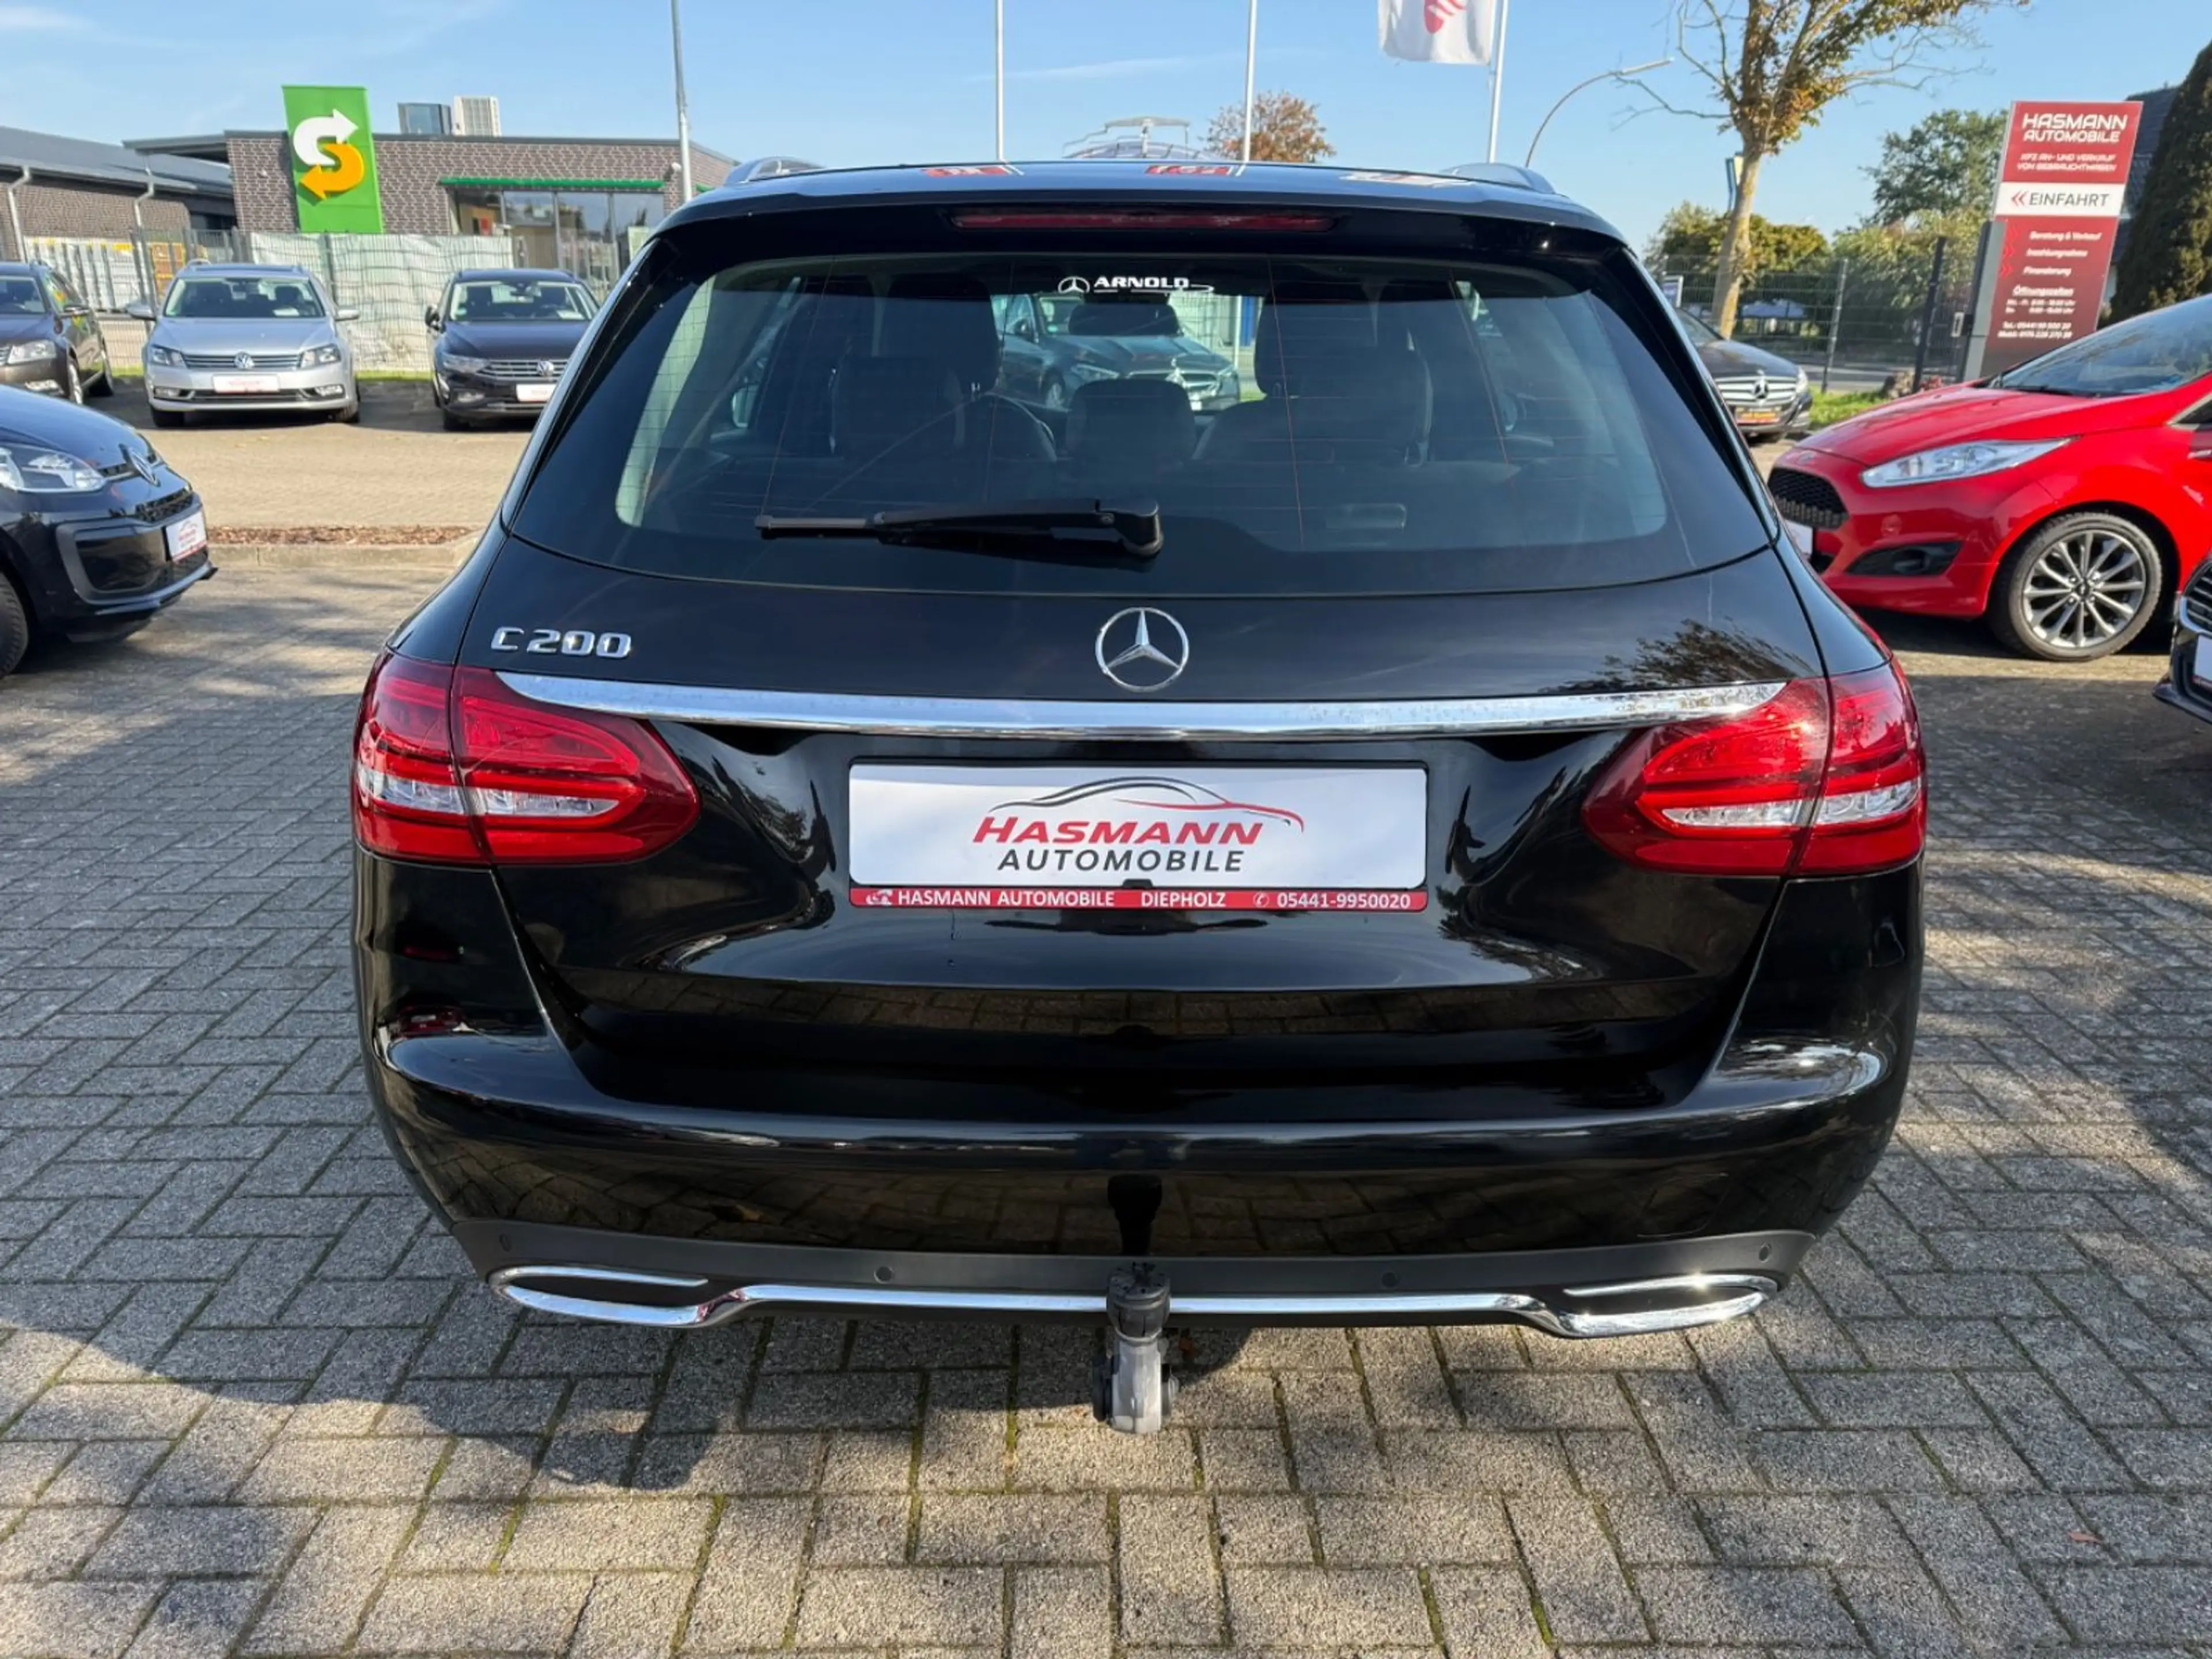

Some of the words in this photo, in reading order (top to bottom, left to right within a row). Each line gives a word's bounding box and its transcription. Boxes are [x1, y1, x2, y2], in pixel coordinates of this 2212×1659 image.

[2022, 113, 2128, 130] HASMANN
[2023, 130, 2121, 143] AUTOMOBILE
[2029, 192, 2109, 206] EINFAHRT
[1093, 276, 1189, 288] ARNOLD
[491, 626, 525, 651] C
[526, 628, 632, 658] 200
[972, 816, 1263, 845] HASMANN
[997, 849, 1244, 872] AUTOMOBILE
[897, 889, 991, 906] HASMANN
[997, 890, 1115, 907] AUTOMOBILE
[1141, 891, 1226, 908] DIEPHOLZ
[1277, 892, 1411, 909] 05441-9950020
